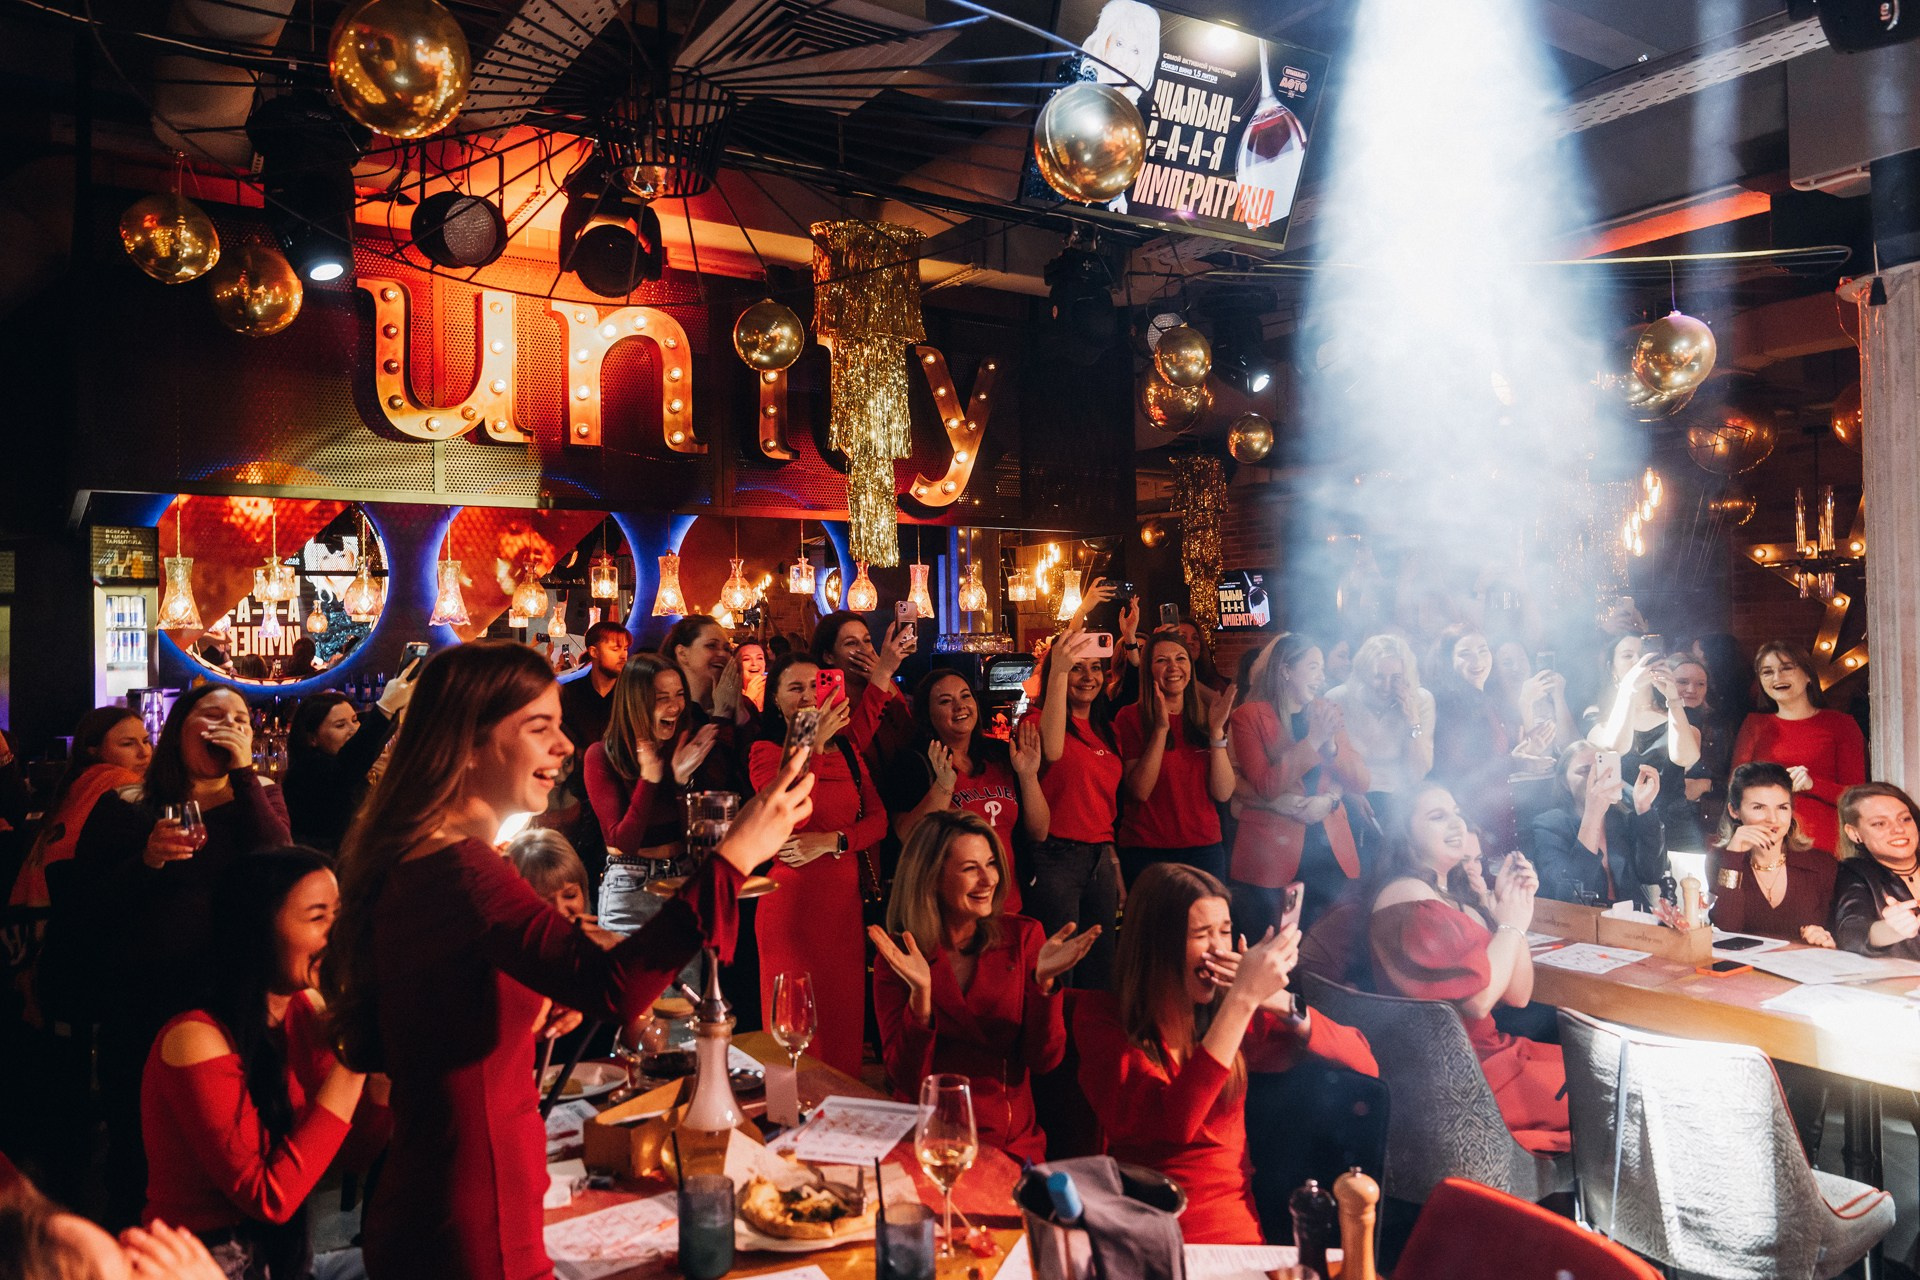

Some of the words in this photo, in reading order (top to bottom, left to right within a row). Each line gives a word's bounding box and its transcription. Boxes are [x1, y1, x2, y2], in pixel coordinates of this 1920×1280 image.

[1161, 61, 1179, 72] бокал
[1150, 79, 1241, 134] ШАЛЬНА-
[1132, 162, 1276, 232] ИМПЕРАТРИЦА
[357, 278, 998, 508] uniy
[952, 785, 1018, 808] PHILLIE
